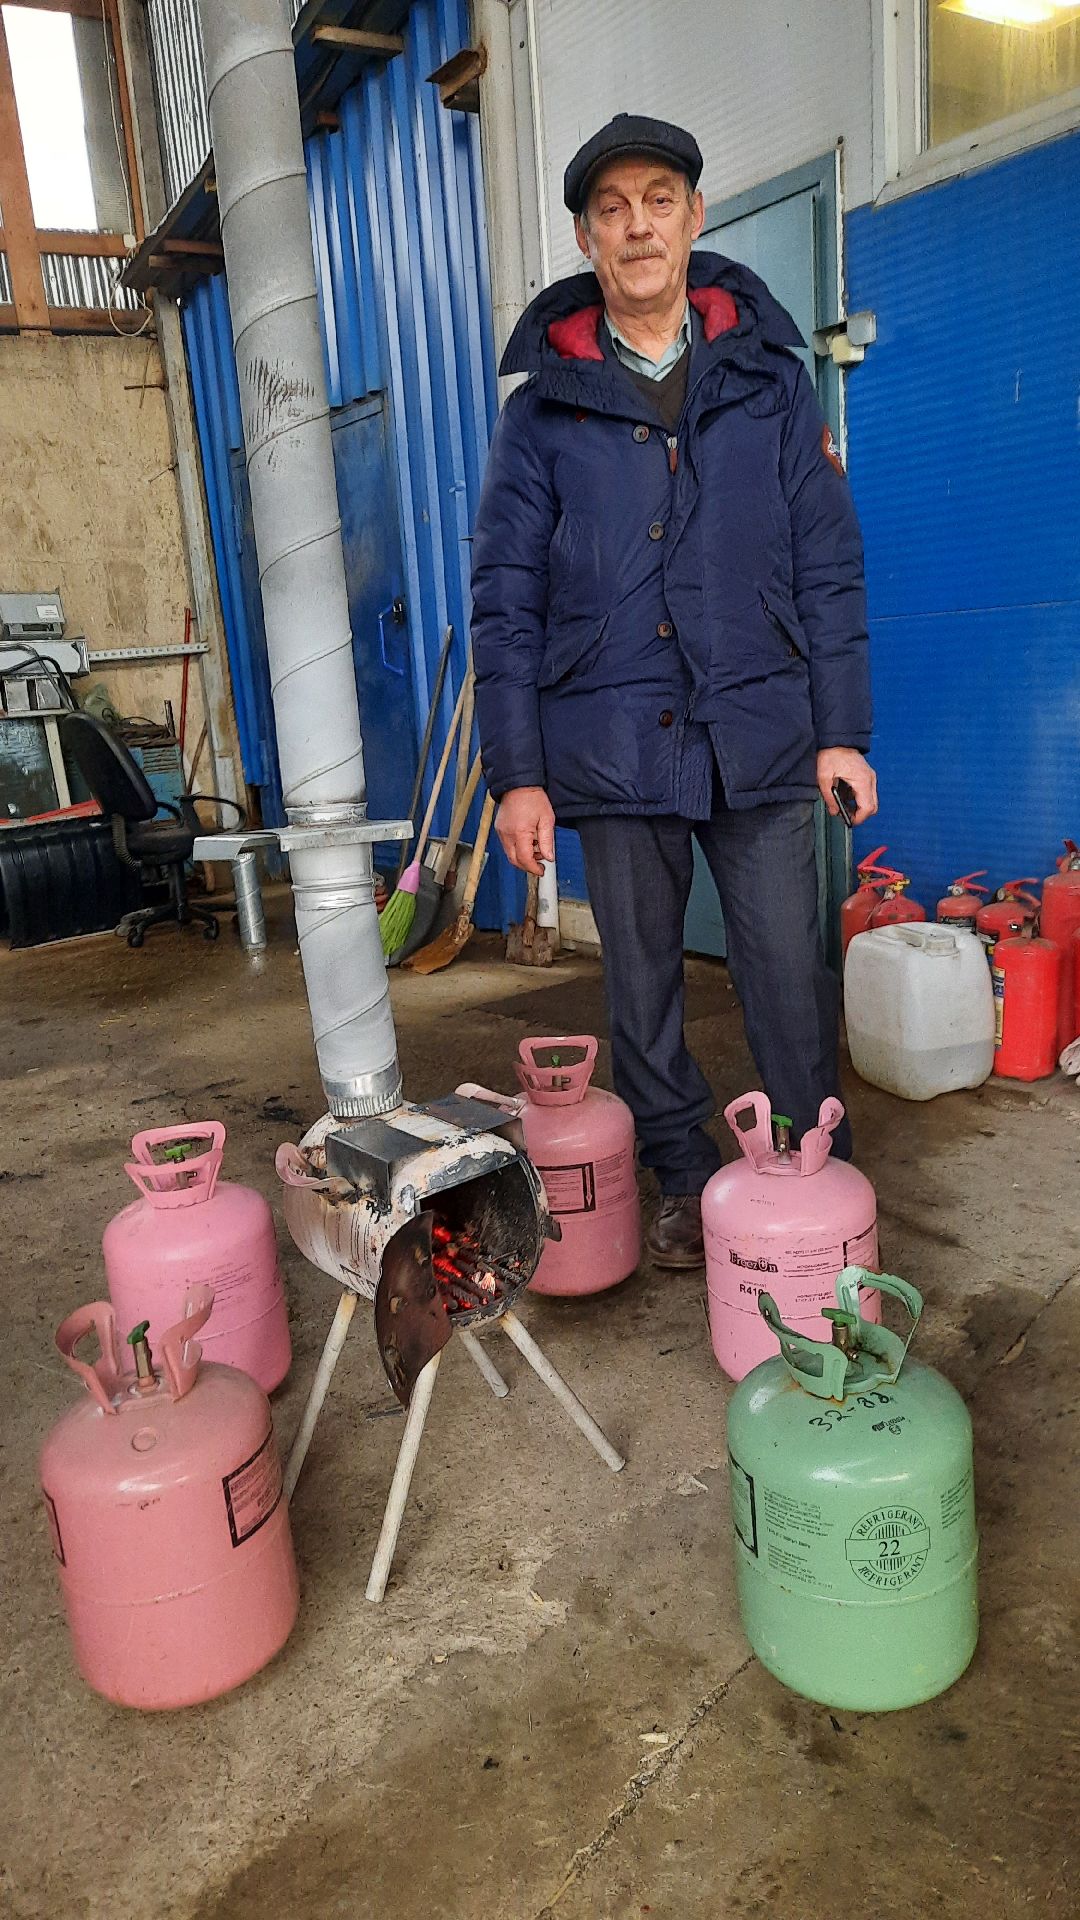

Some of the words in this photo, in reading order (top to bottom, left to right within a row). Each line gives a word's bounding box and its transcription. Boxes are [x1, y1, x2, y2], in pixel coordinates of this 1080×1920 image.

[739, 1283, 769, 1298] R410
[857, 1510, 924, 1537] REFRIGERANT
[878, 1539, 902, 1558] 22
[858, 1555, 925, 1588] REFRIGERANT
